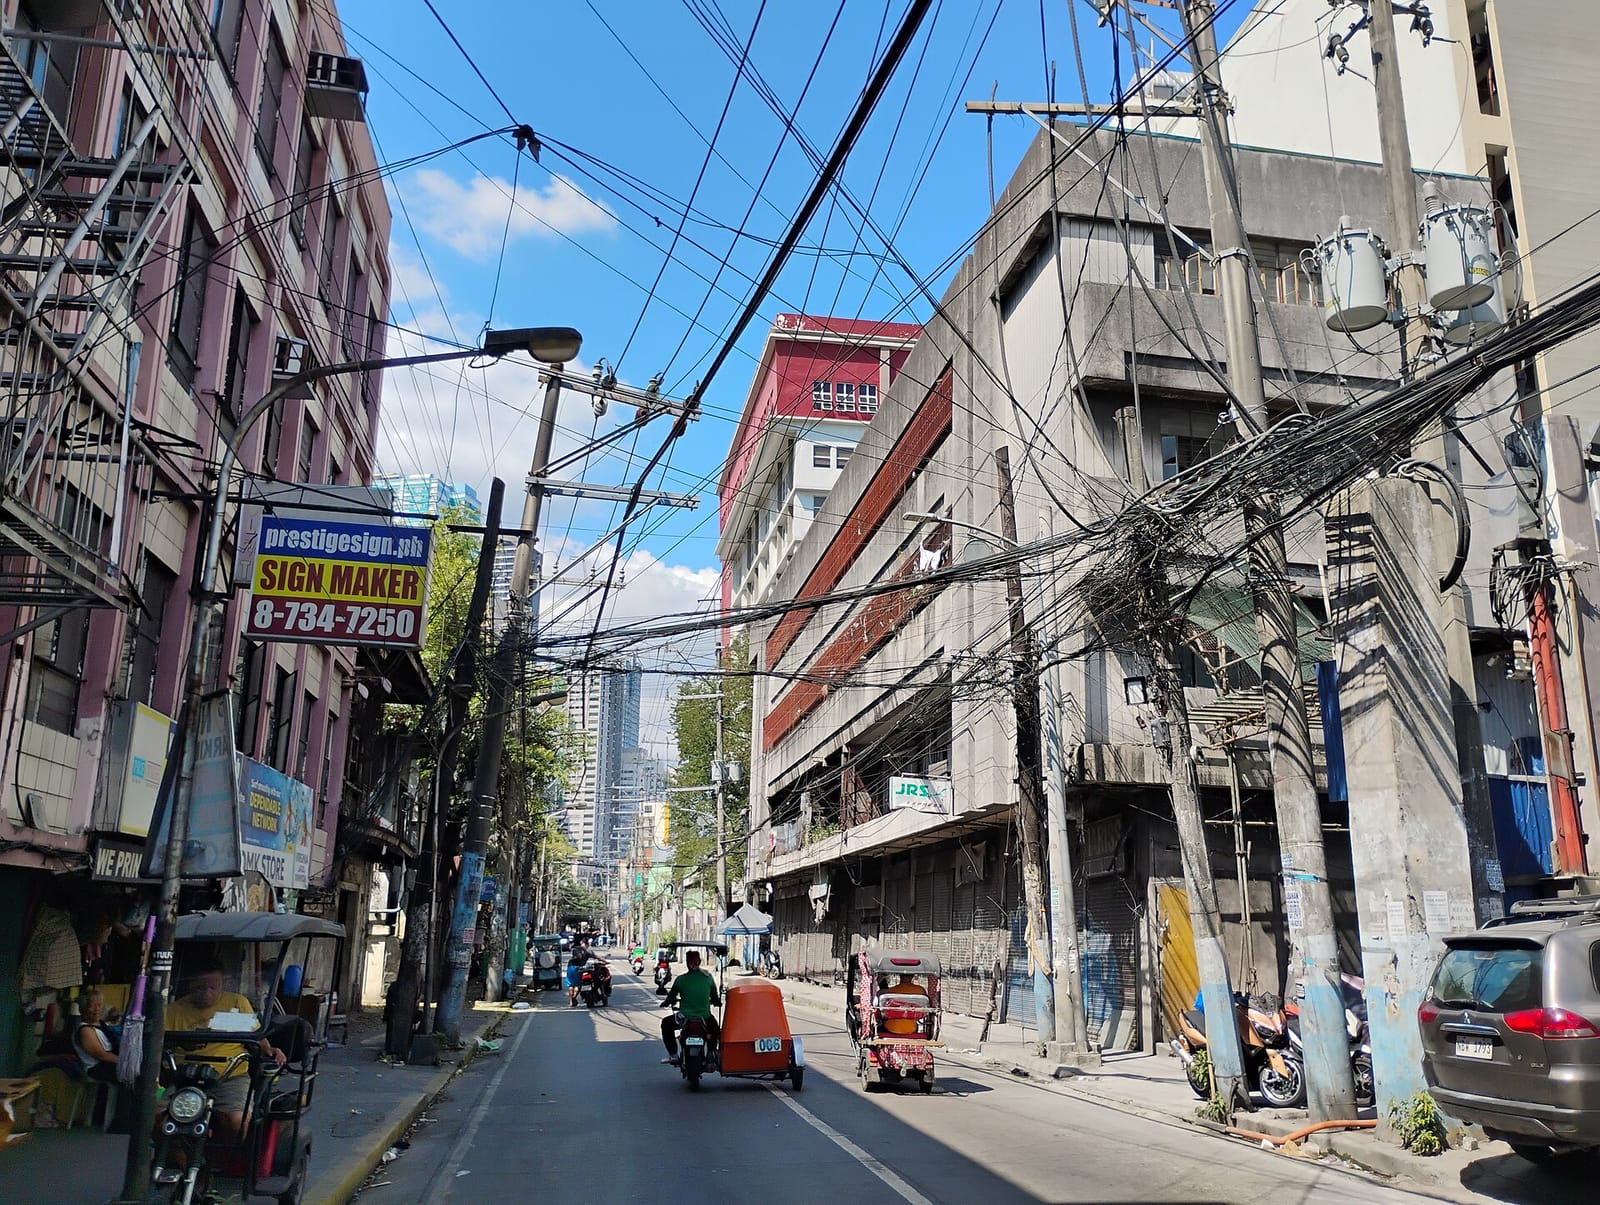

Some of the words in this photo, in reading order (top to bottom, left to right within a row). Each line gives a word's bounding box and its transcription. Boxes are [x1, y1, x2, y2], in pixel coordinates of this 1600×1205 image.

[265, 527, 423, 558] prestigesign.ph
[260, 559, 325, 593] SIGN
[329, 564, 420, 600] MAKER
[253, 599, 415, 638] 8-734-7250
[250, 791, 281, 816] DEPENDABLE
[895, 783, 929, 797] JRS
[252, 811, 278, 833] NETWORK
[96, 847, 116, 876] WE
[115, 851, 143, 879] PRIN
[262, 854, 285, 881] STORE
[759, 1038, 781, 1051] 006
